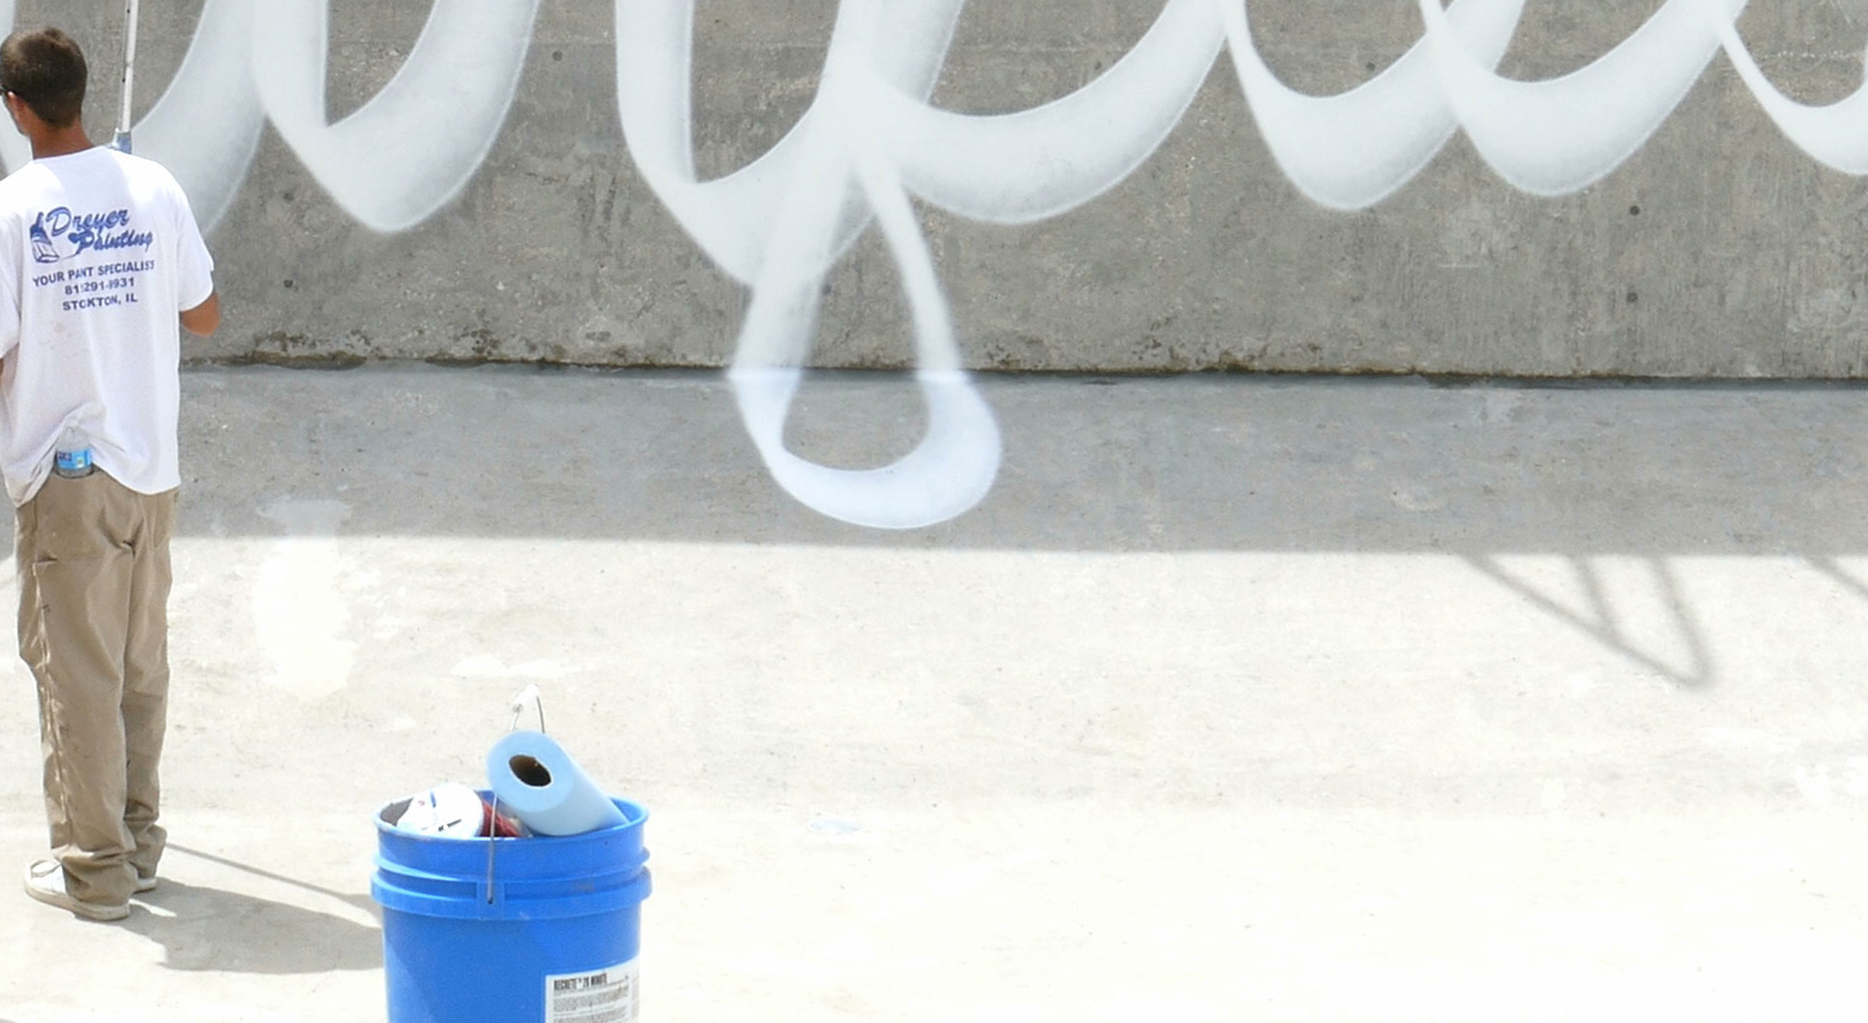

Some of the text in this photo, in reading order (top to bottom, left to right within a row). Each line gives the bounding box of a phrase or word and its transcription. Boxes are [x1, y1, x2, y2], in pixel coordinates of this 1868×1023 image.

[45, 206, 130, 237] Dreyer
[68, 229, 153, 255] Painting
[32, 271, 65, 287] YOUR
[68, 266, 93, 281] PANT
[125, 292, 138, 303] IL
